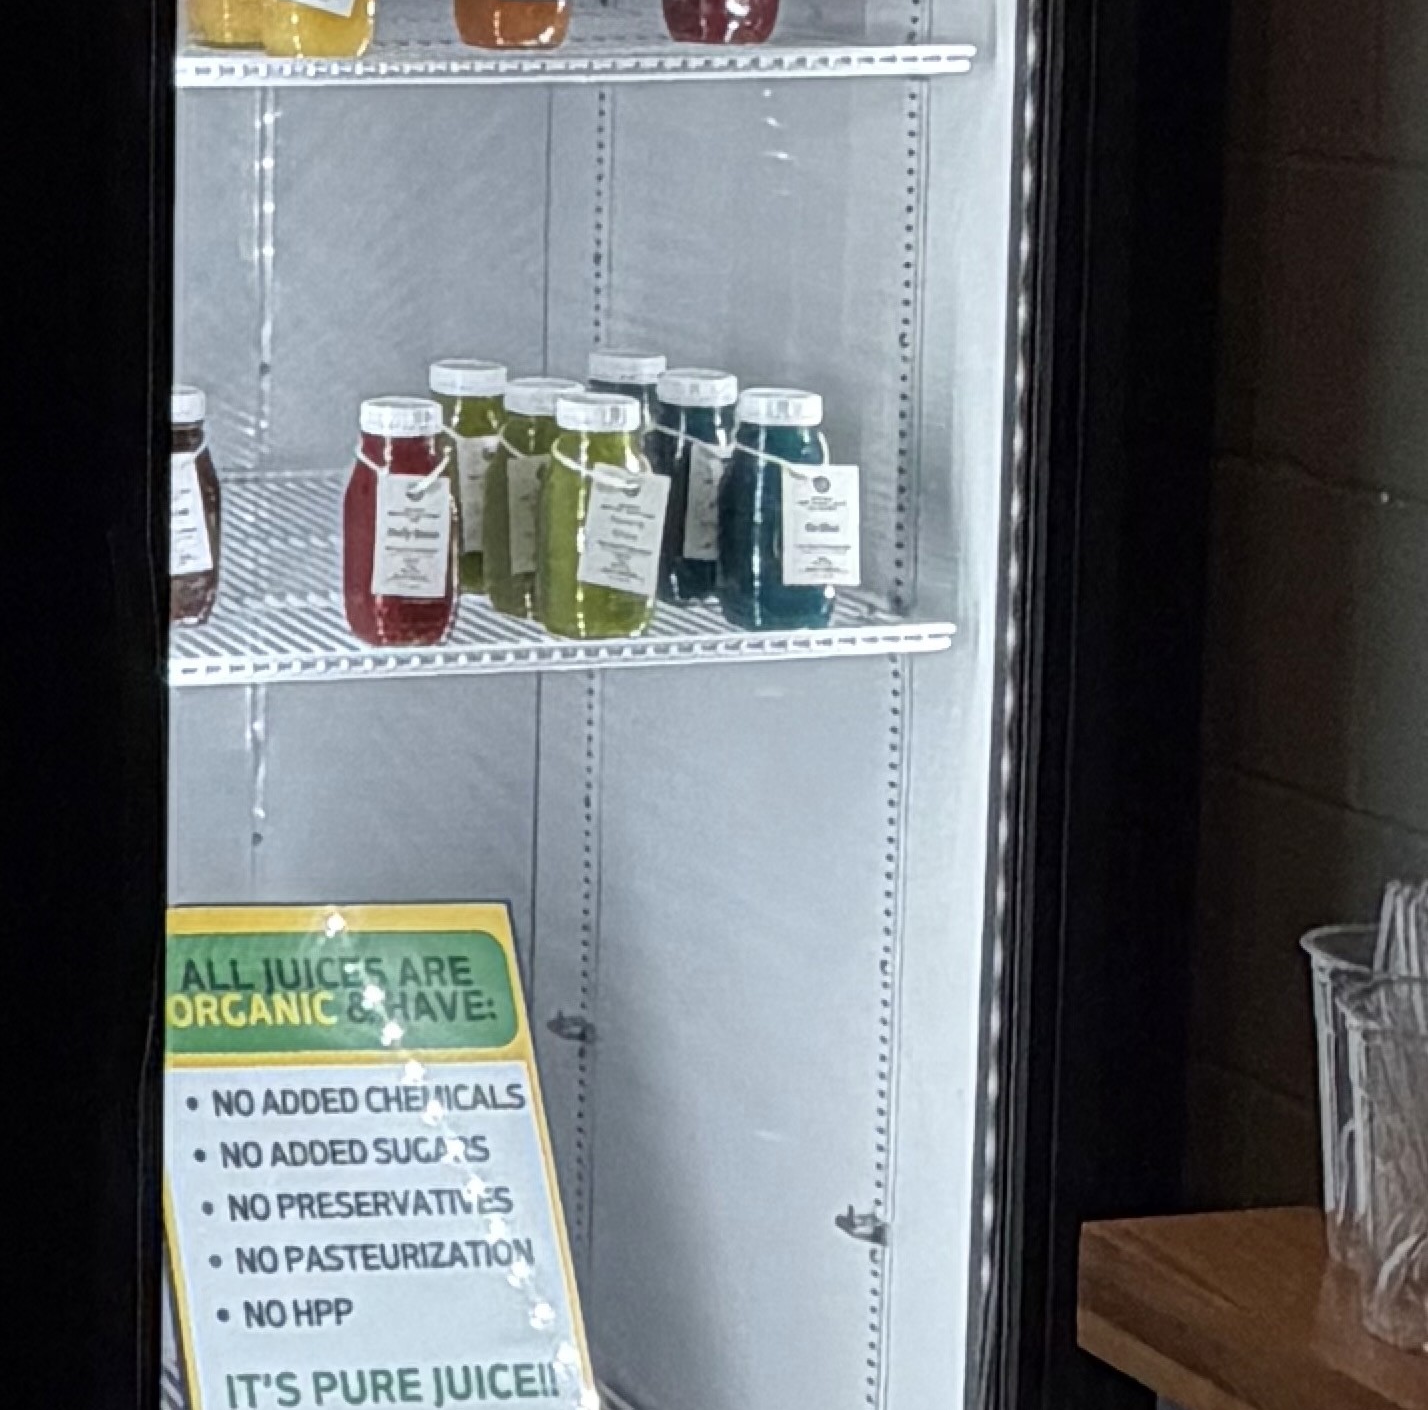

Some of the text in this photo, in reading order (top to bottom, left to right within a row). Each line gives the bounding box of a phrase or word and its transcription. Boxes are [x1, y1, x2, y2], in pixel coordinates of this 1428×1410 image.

[181, 955, 474, 992] ALL JUICES ARE
[167, 992, 339, 1028] ORGANIC
[212, 1083, 526, 1118] NO ADDED CHEMICALS
[220, 1141, 263, 1169] NO
[270, 1138, 368, 1167] ADDED
[228, 1186, 514, 1222] NO PRESERVATIVES
[235, 1238, 536, 1274] NO PASTEURIZATION
[243, 1297, 354, 1328] NO HPP
[225, 1371, 302, 1410] IT'S
[312, 1367, 423, 1406] PURE
